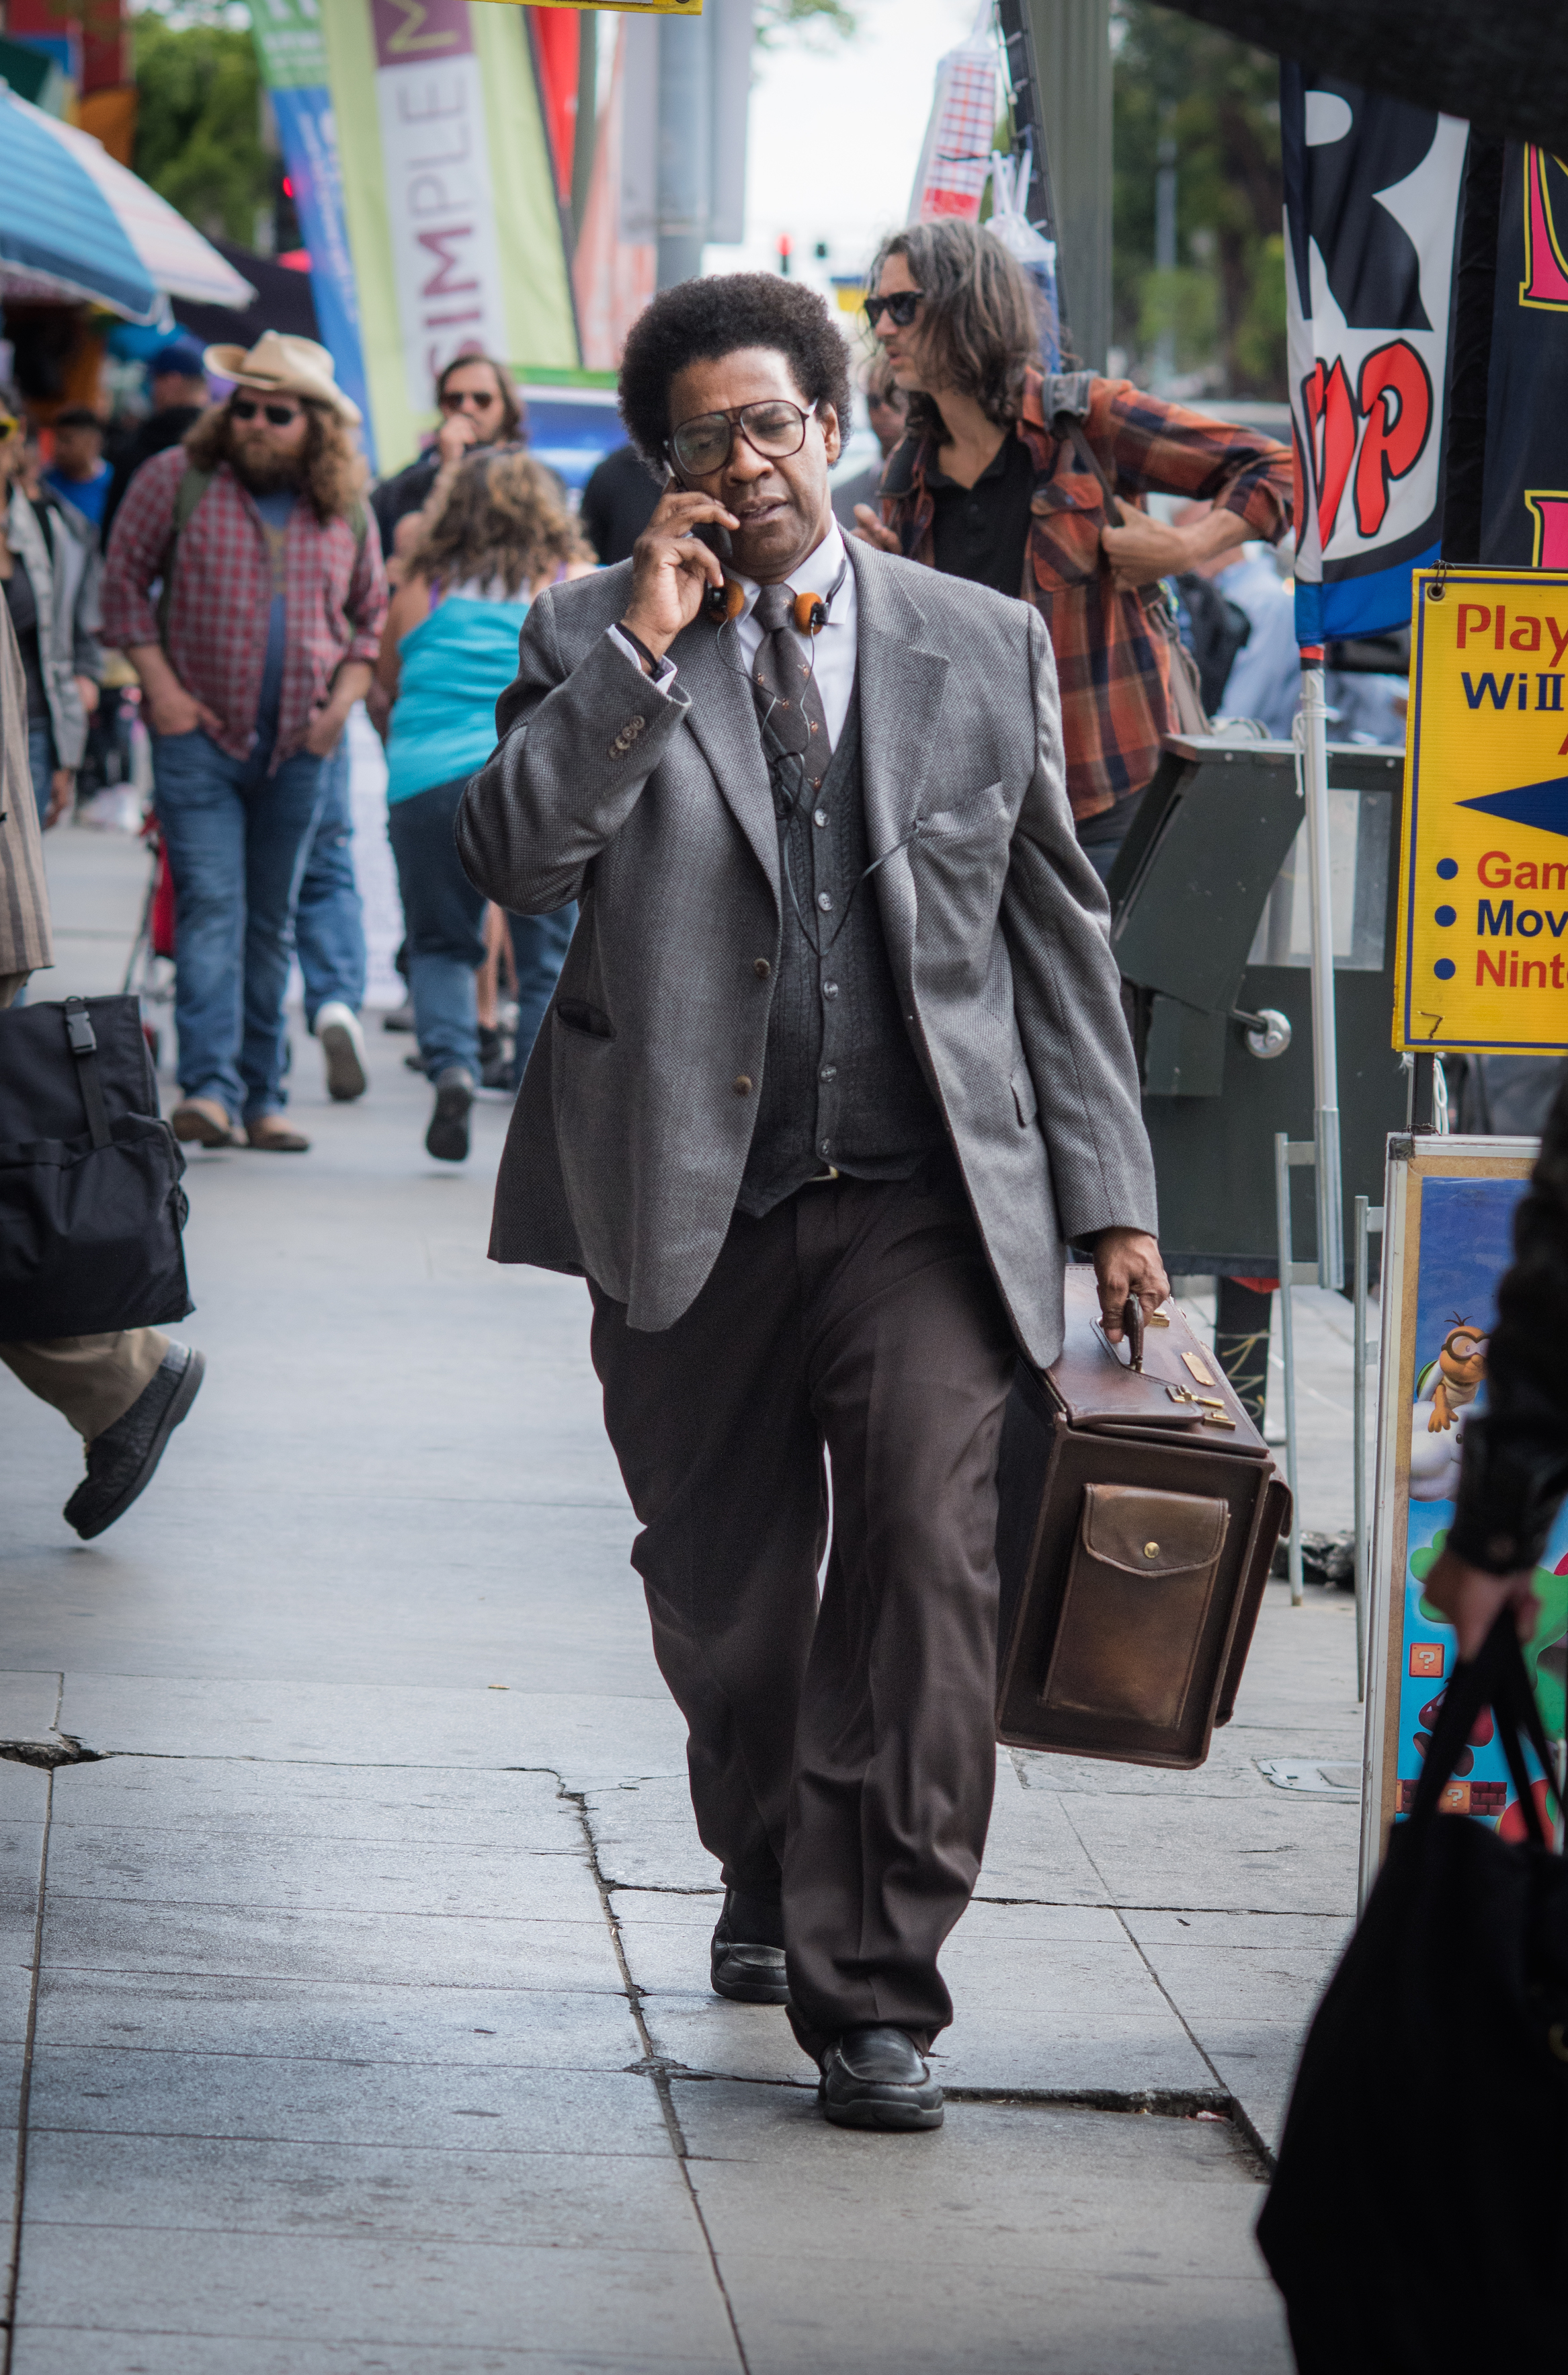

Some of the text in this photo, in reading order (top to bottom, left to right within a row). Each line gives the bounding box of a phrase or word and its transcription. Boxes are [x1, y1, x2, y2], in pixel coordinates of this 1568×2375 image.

[1456, 604, 1568, 668] Play
[1477, 850, 1568, 890] Gam
[1477, 899, 1568, 937] Mov
[1476, 949, 1568, 990] Nint
